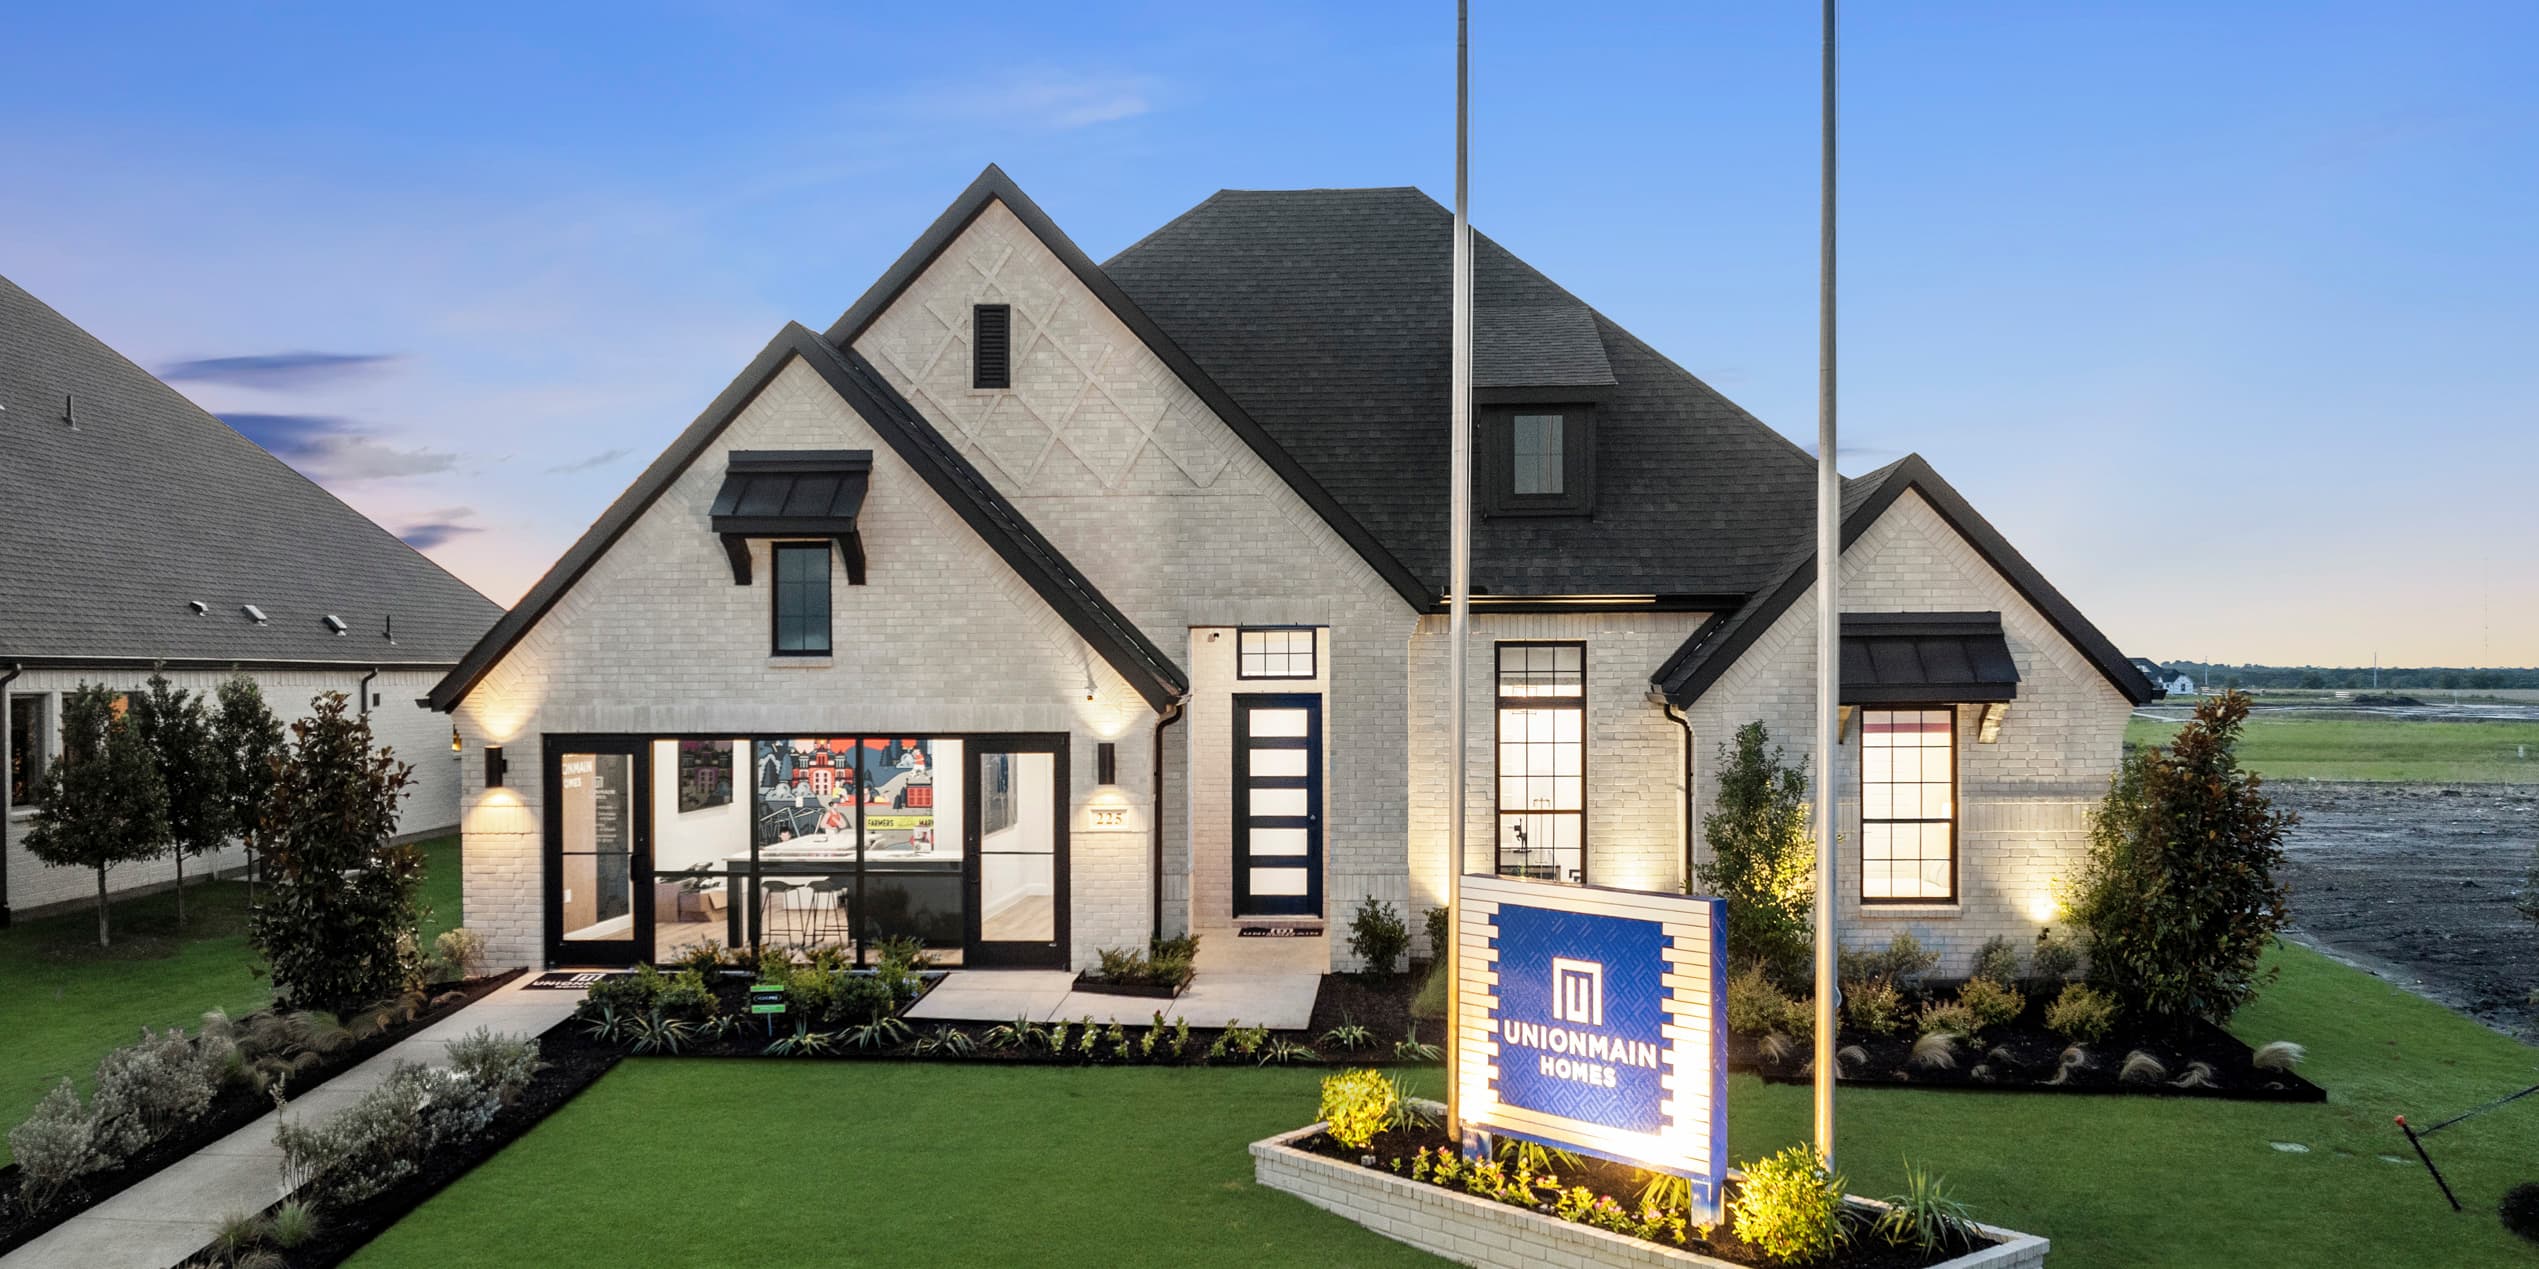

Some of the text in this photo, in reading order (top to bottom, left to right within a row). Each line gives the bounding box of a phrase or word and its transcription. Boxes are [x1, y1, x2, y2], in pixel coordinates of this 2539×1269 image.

[868, 819, 894, 827] FARMERS
[1096, 812, 1123, 825] 225
[1503, 1018, 1658, 1070] UNIONMAIN
[1539, 1054, 1617, 1089] HOMES
